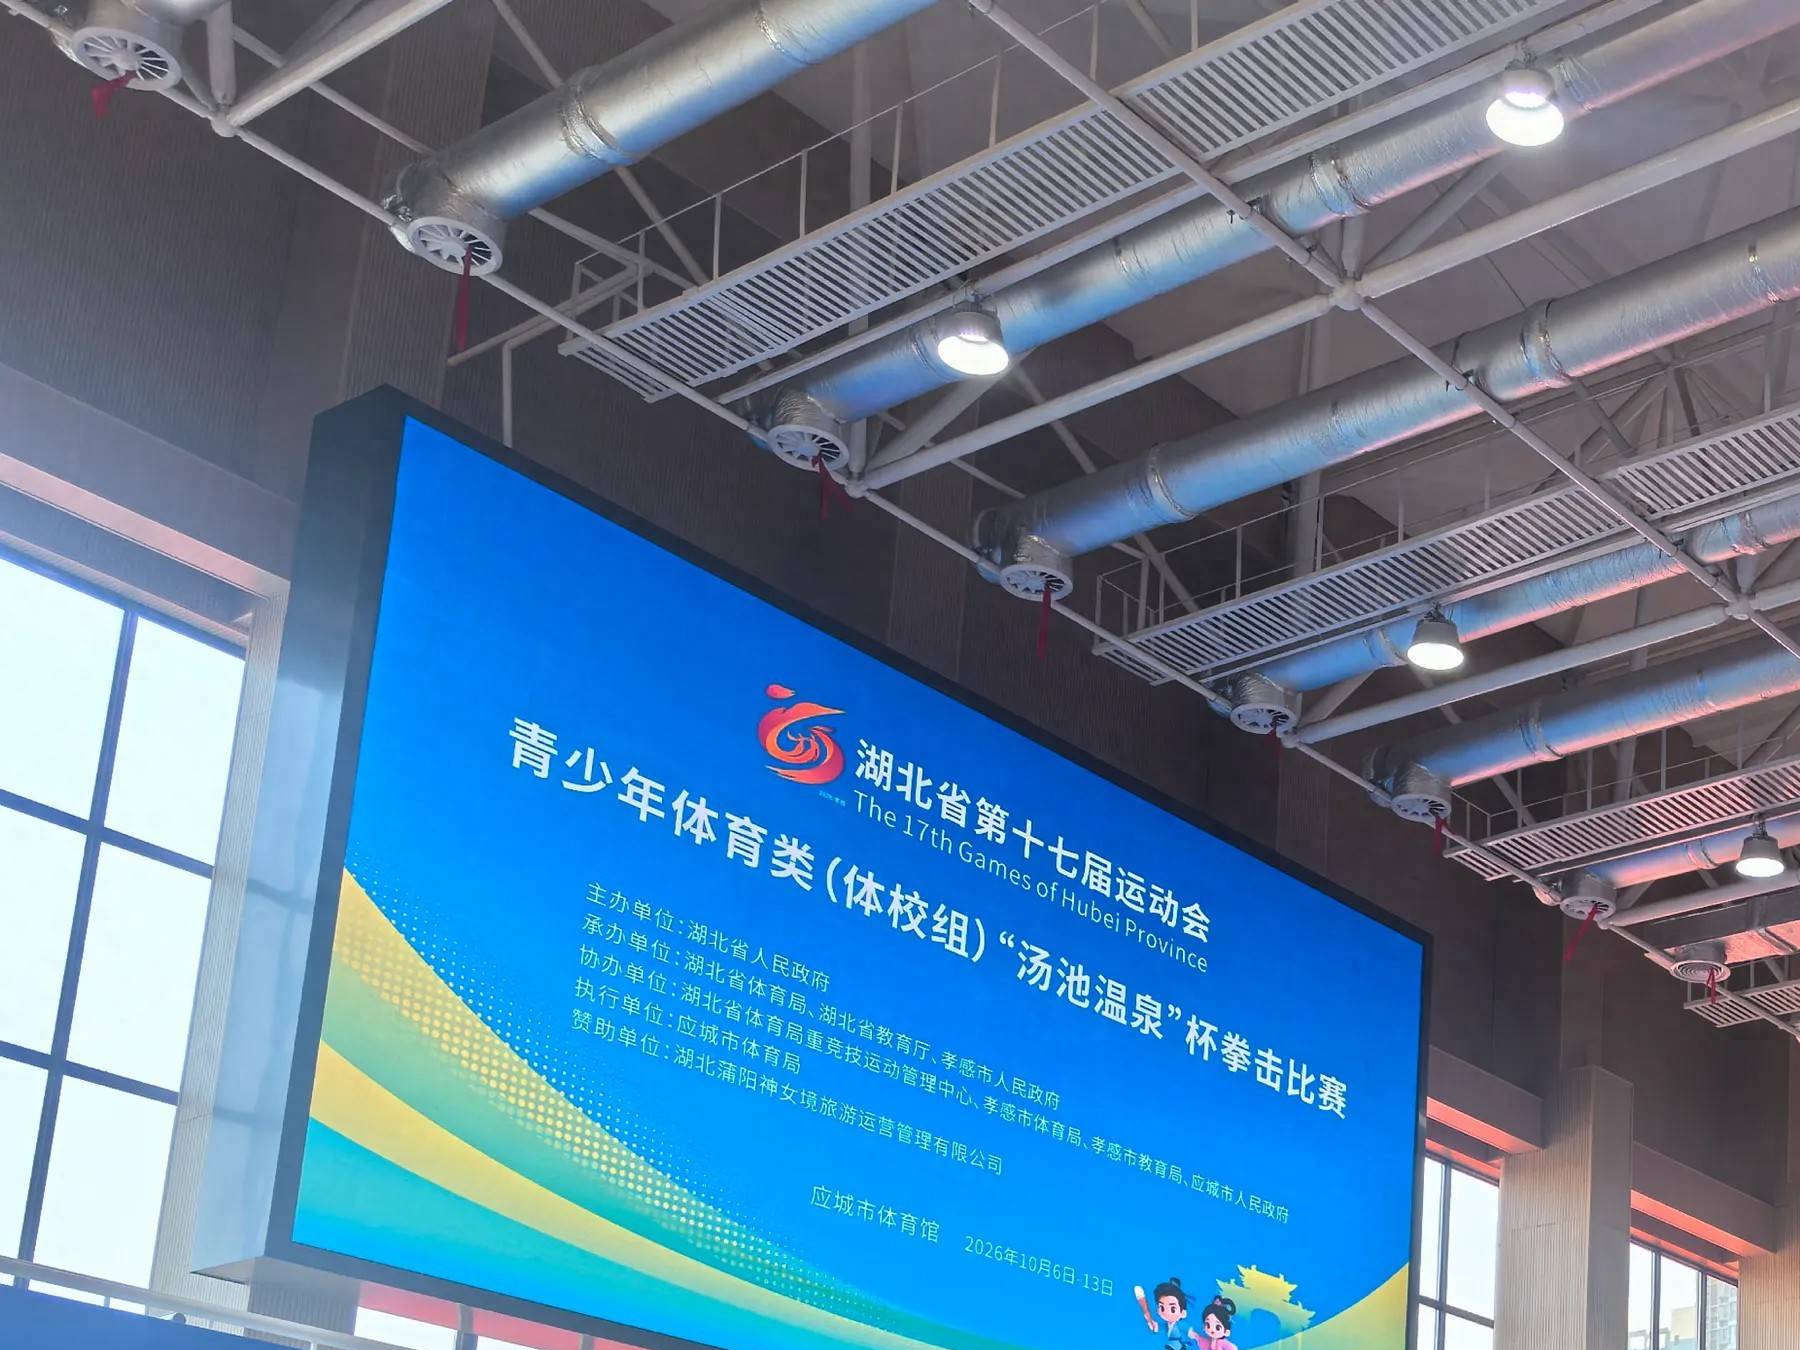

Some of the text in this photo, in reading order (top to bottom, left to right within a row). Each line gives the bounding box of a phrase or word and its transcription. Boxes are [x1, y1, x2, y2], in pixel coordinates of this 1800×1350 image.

[853, 789, 897, 828] The
[902, 814, 953, 854] 17th
[959, 840, 1032, 891] Games
[1036, 879, 1058, 902] of
[1062, 891, 1120, 932] Hubei
[1126, 918, 1209, 973] Province
[855, 738, 1211, 943] 湖北省第十七届运动会
[586, 881, 830, 993] 主办单位：湖北省人民政府
[810, 1184, 941, 1244] 应城市体育馆
